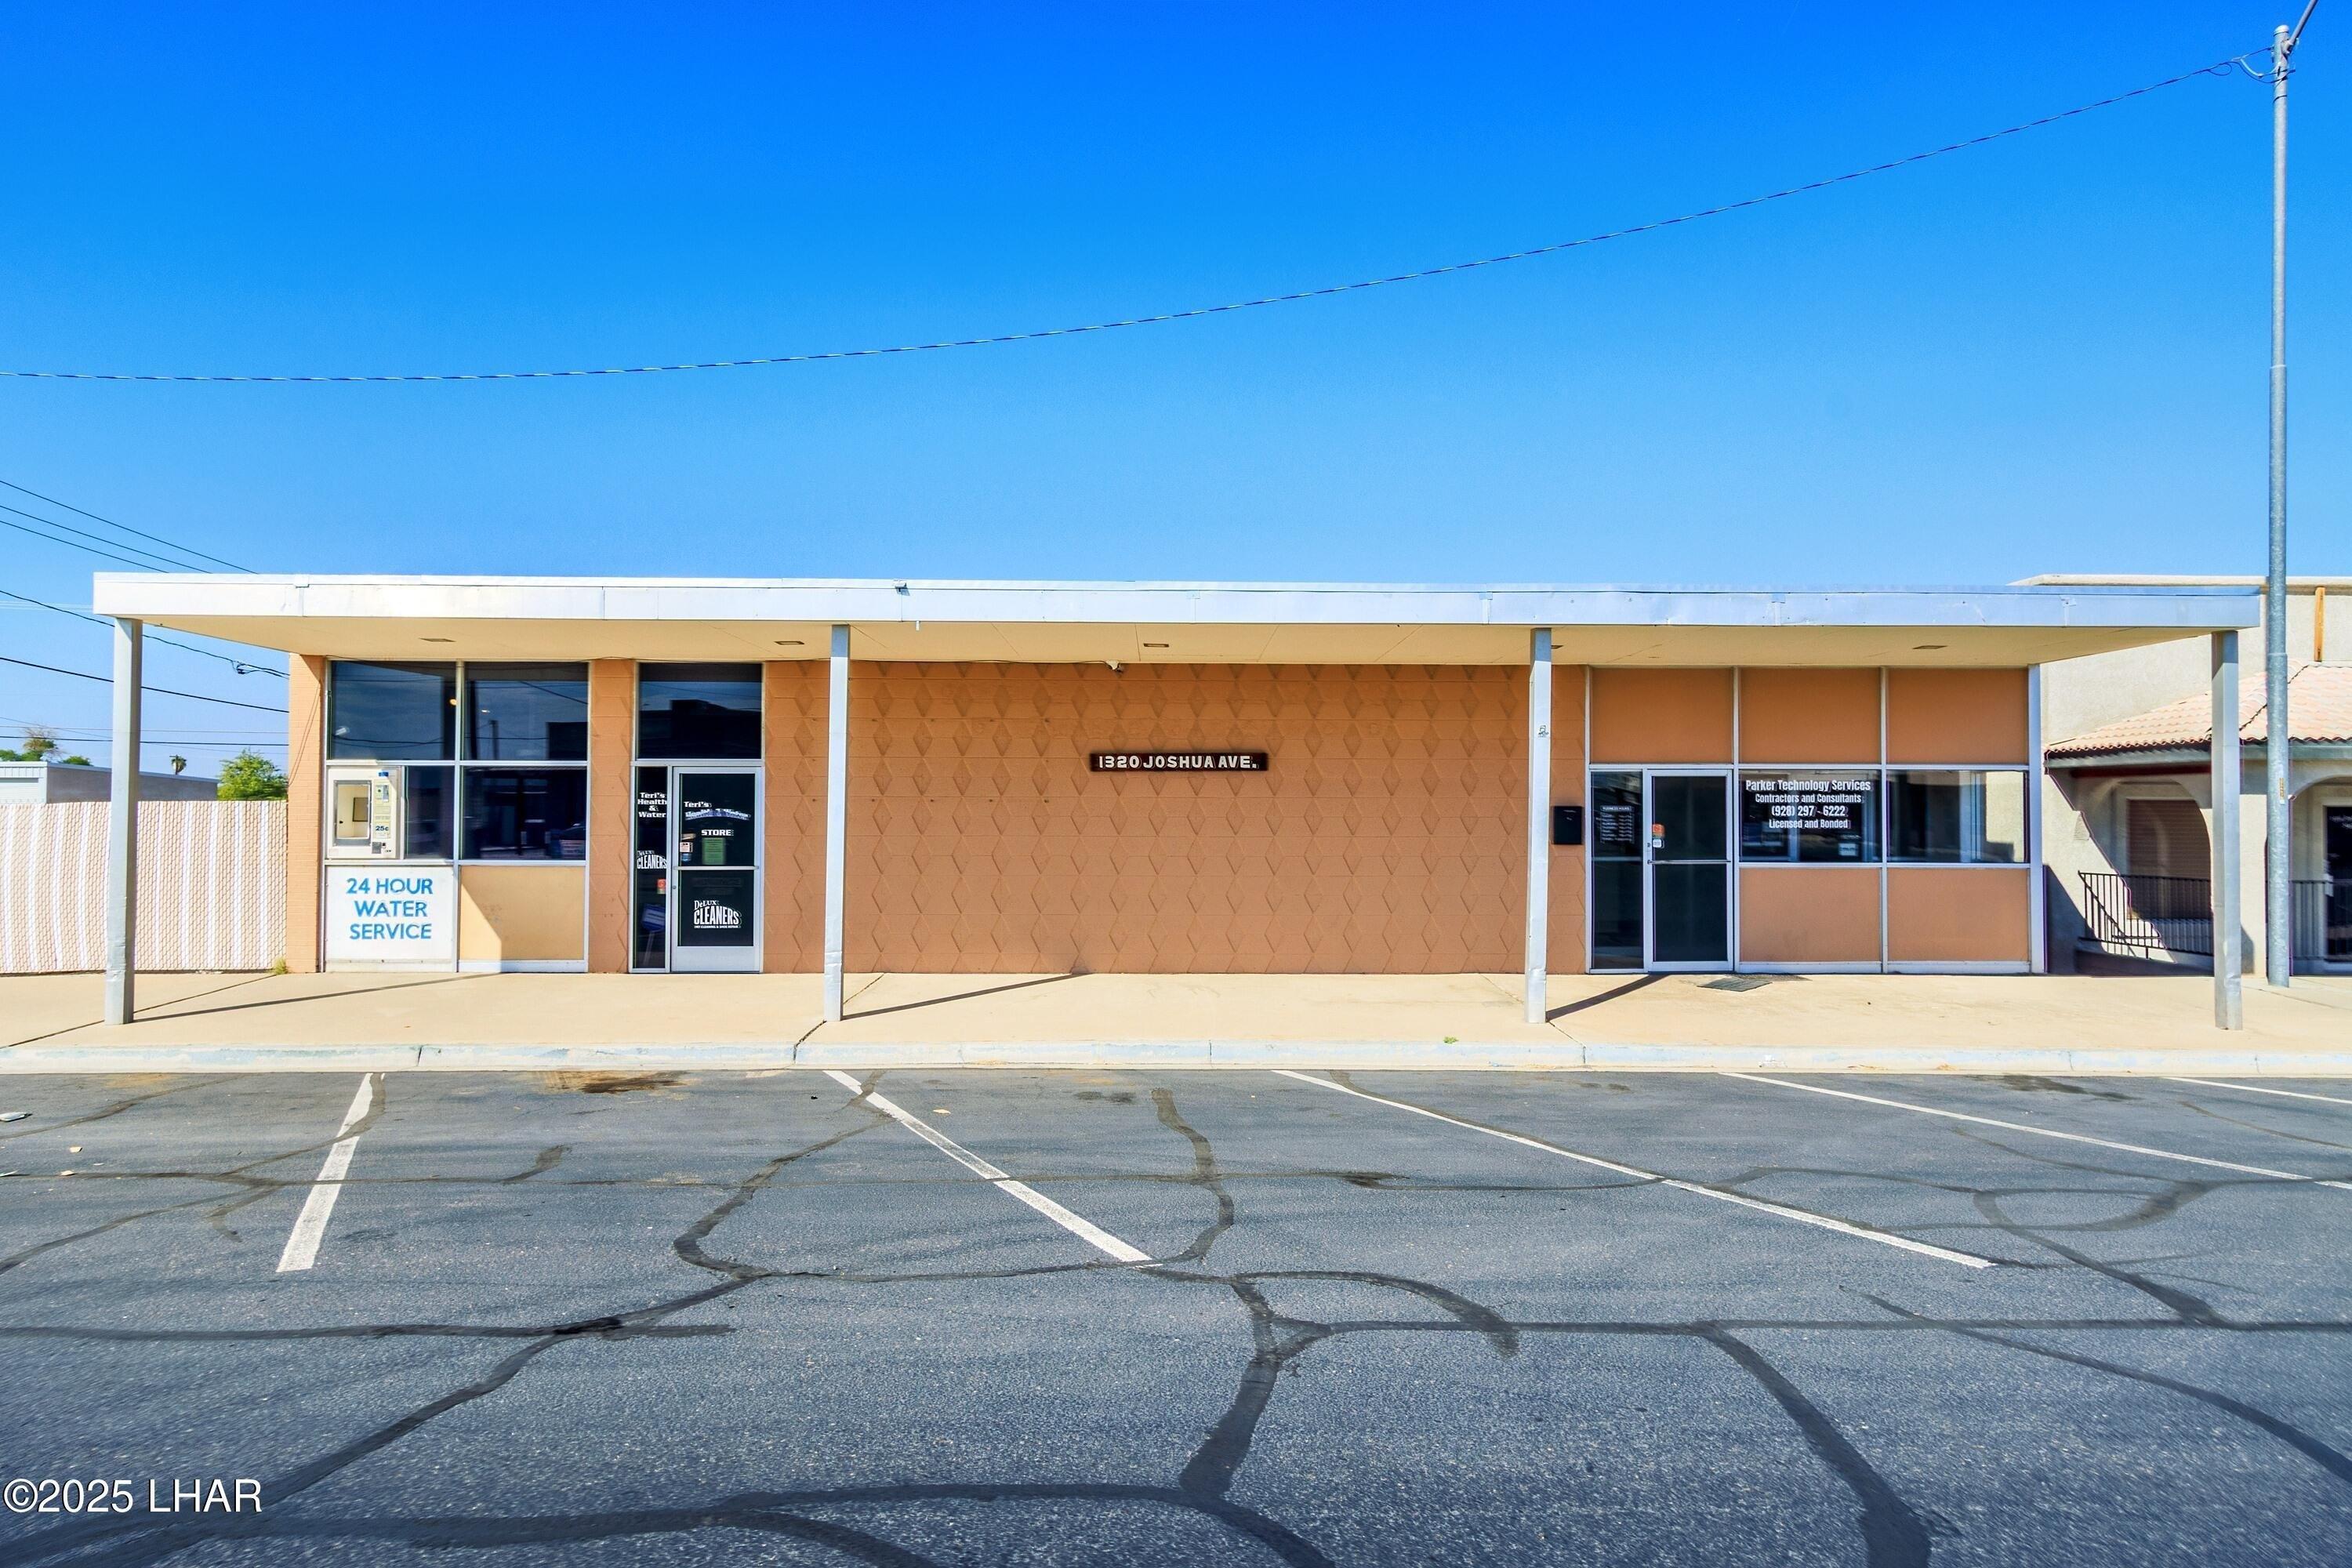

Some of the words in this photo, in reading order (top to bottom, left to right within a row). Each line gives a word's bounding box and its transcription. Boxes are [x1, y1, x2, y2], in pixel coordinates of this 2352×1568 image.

[1099, 756, 1138, 768] 1320
[1143, 756, 1214, 768] JOSHUA
[1218, 756, 1258, 768] AVE.
[1746, 780, 1776, 791] Parker
[1777, 780, 1829, 792] Technology
[1831, 780, 1871, 791] Services
[1755, 793, 1799, 803] Contractors
[1801, 793, 1815, 803] and
[1817, 793, 1862, 803] Consultants
[1772, 805, 1795, 817] (928)
[1798, 805, 1814, 816] 297
[1823, 805, 1846, 816] 6222
[1769, 819, 1802, 829] Licensed
[1804, 819, 1818, 829] and
[1820, 819, 1848, 829] Bonded
[637, 855, 667, 869] CLEANERS
[346, 877, 370, 895] 24
[376, 877, 434, 895] HOUR
[354, 900, 428, 917] WATER
[694, 906, 740, 925] CLEANERS
[350, 924, 433, 940] SERVICE
